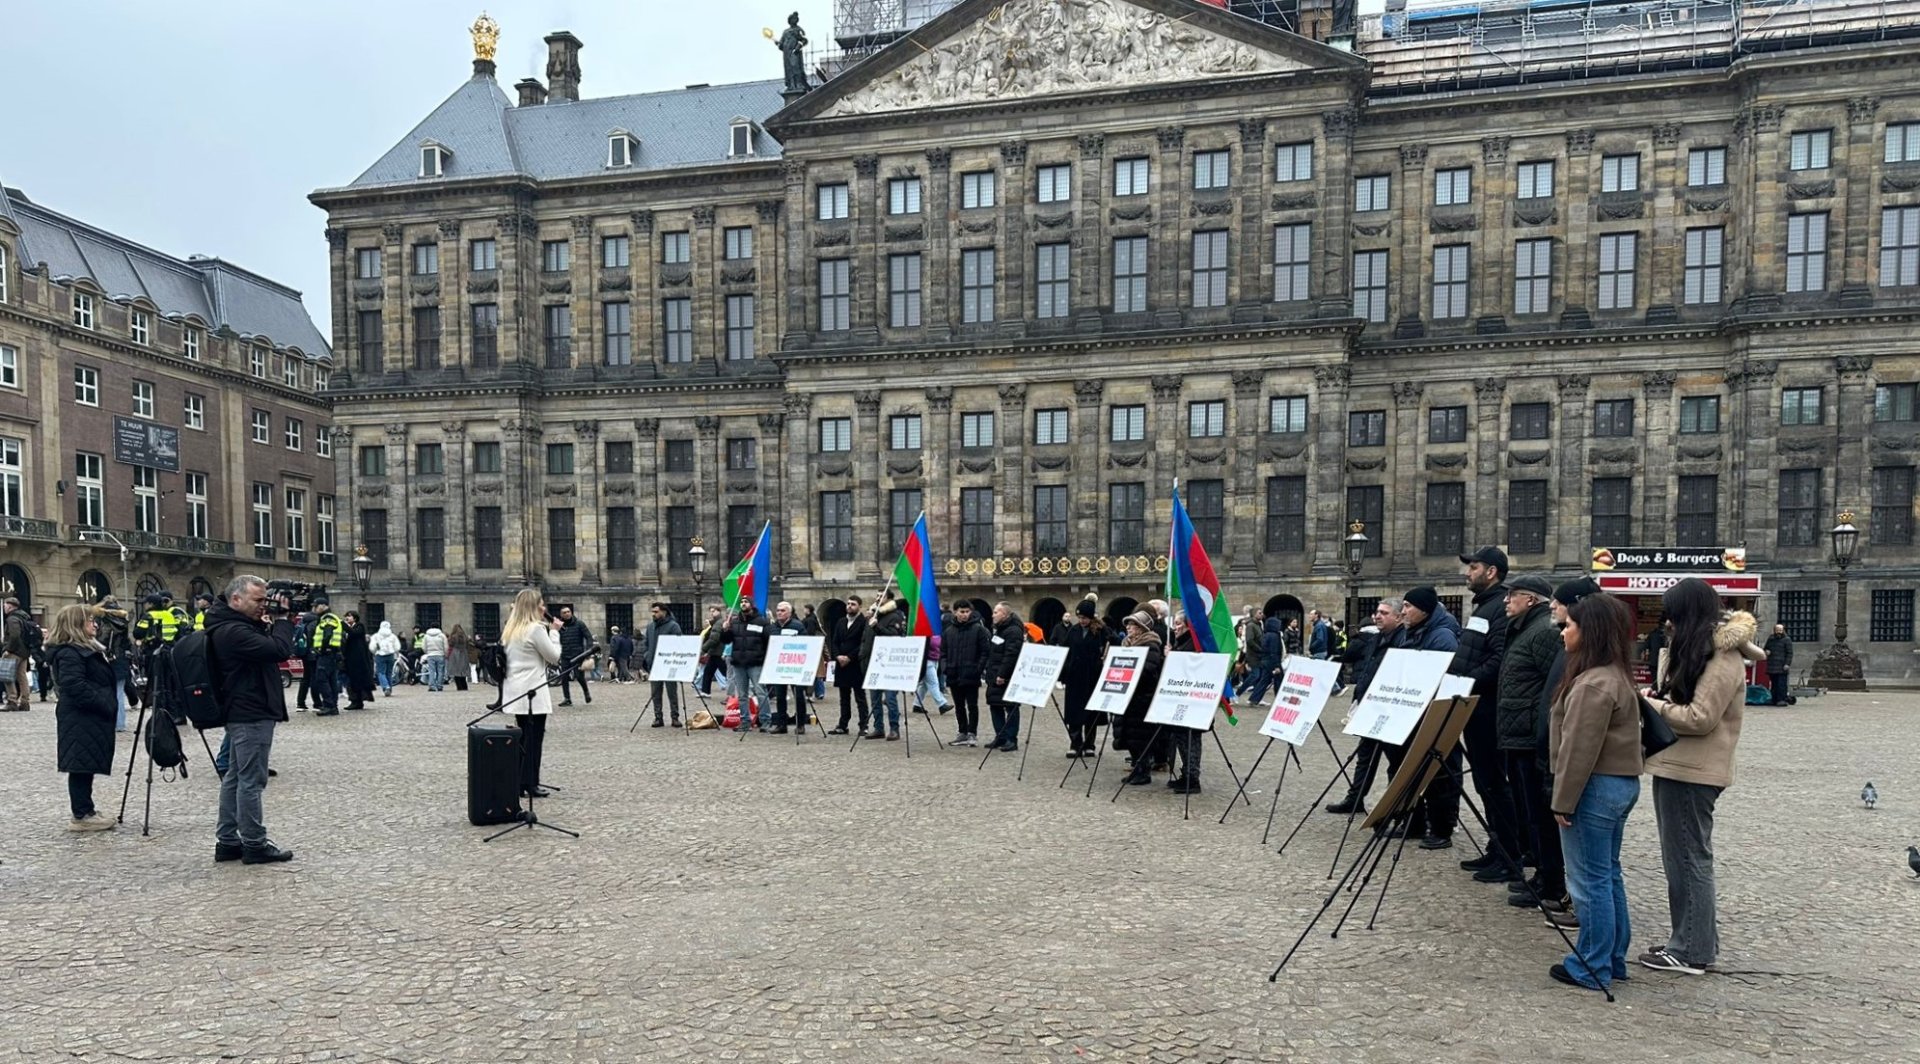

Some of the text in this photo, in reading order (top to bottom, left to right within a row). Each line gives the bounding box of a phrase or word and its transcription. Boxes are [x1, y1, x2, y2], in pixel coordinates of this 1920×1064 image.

[1617, 552, 1720, 564] Dogs & Burgers
[1628, 577, 1683, 588] HOTDO
[778, 653, 808, 664] DEMAND
[1160, 688, 1218, 700] Remember KHOJALY
[1380, 684, 1394, 692] Voices
[1402, 688, 1422, 696] Justice
[1367, 694, 1392, 702] Remember
[1400, 699, 1424, 708] Innocent
